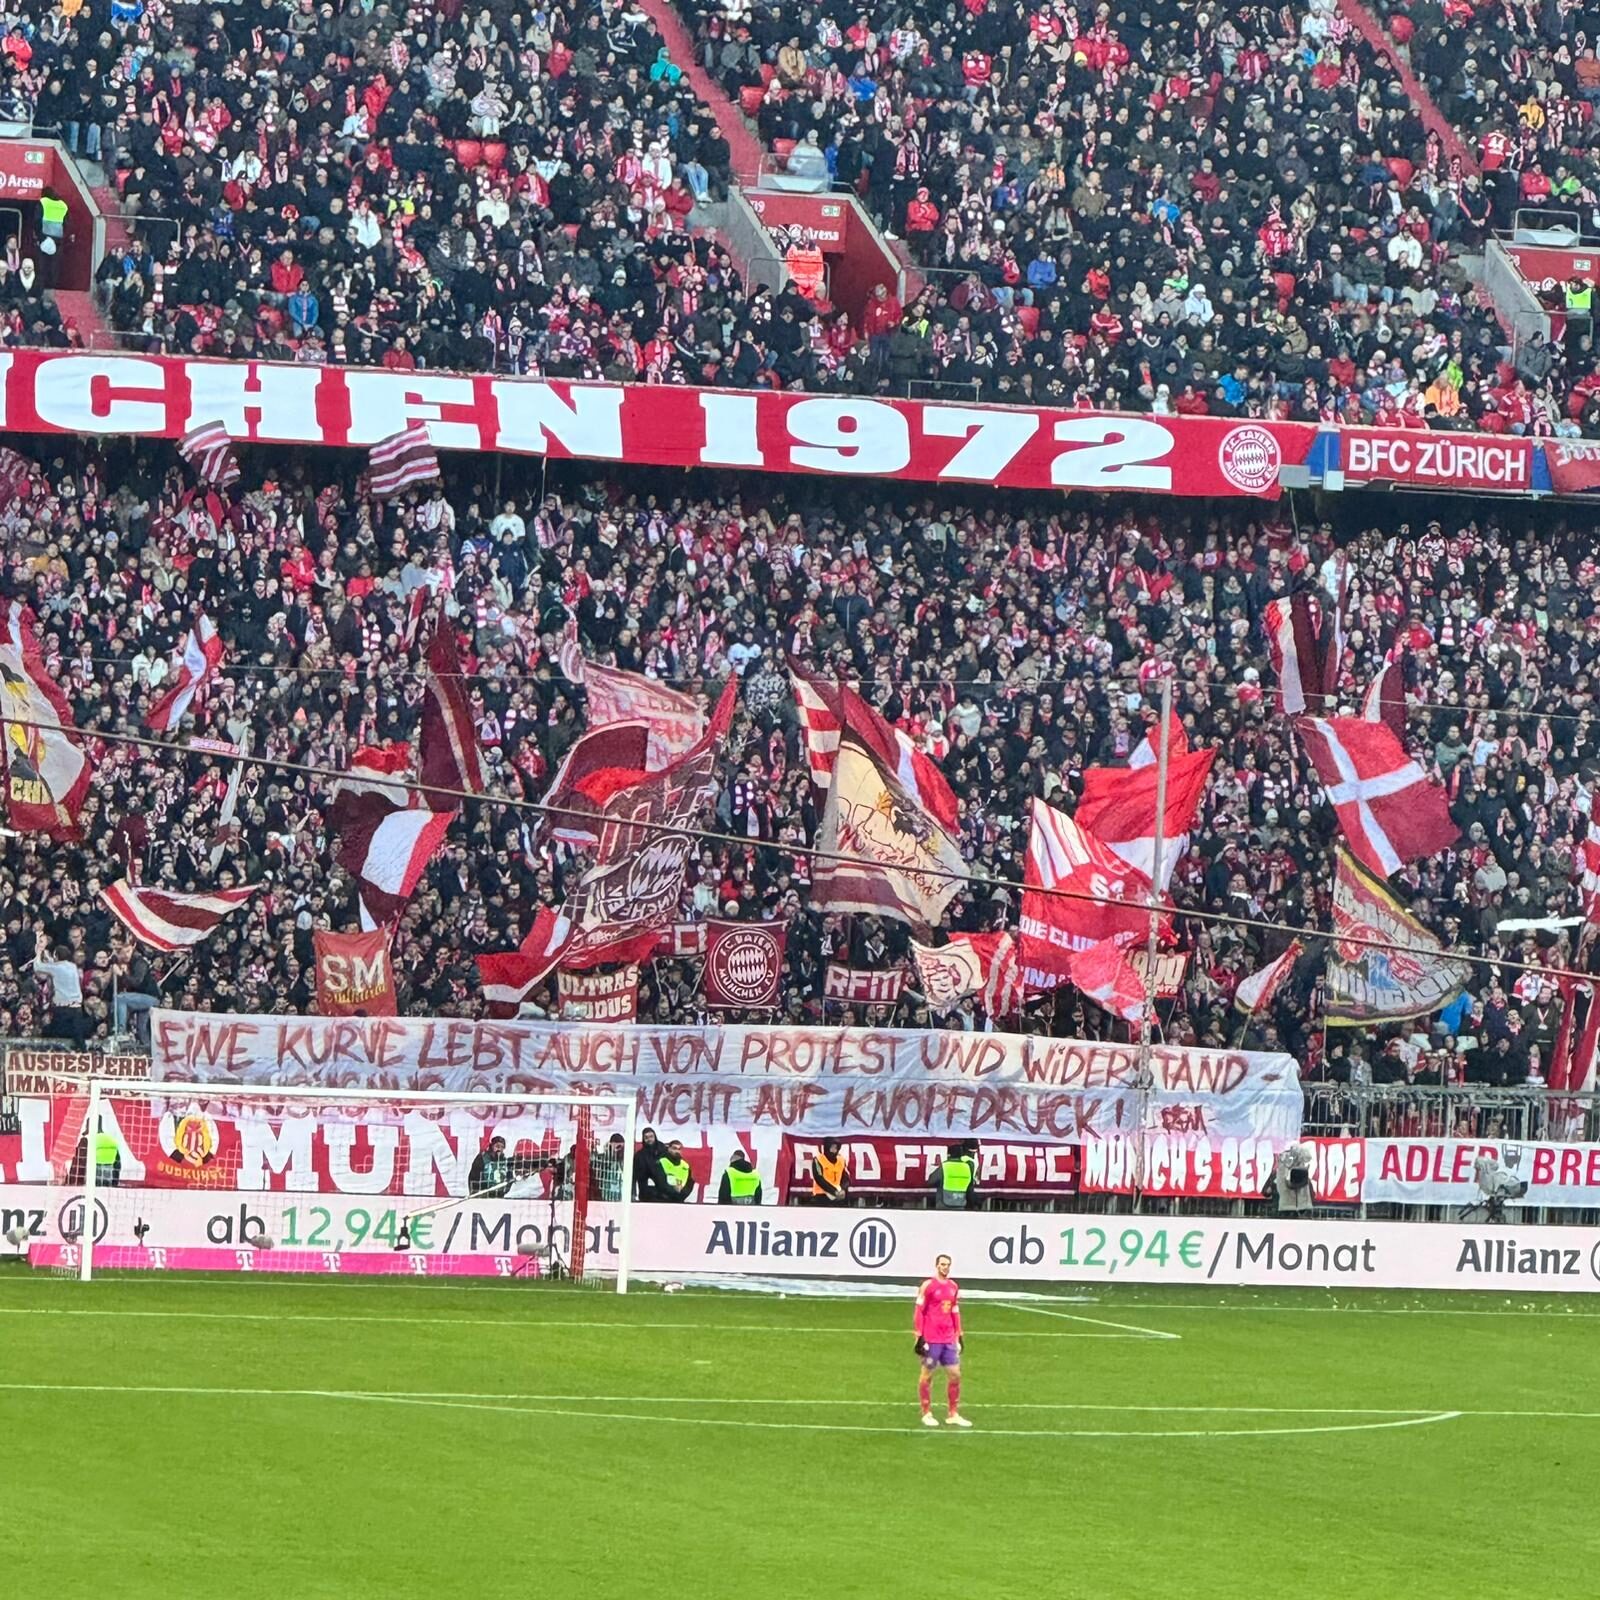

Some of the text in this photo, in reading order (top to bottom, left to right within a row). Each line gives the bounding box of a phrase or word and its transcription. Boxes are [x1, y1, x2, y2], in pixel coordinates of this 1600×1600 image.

[0, 353, 1175, 491] CHEN 1972
[1349, 437, 1410, 474] BFC
[1415, 440, 1526, 481] ZÜRICH
[322, 950, 386, 993] SM
[557, 965, 638, 996] ULTRAS
[277, 1020, 407, 1071] KURVE
[418, 1022, 531, 1071] LEBT
[535, 1031, 640, 1075] AUCH
[650, 1030, 725, 1074] VON
[740, 1028, 906, 1075] PROTEST
[921, 1032, 1006, 1077] UND
[752, 1083, 828, 1125] AUF
[794, 1142, 880, 1181] RD
[1531, 1147, 1600, 1187] BRE
[206, 1203, 266, 1245] ab
[705, 1220, 839, 1258] Allianz
[989, 1225, 1045, 1265] ab
[1456, 1238, 1580, 1275] Allianz
